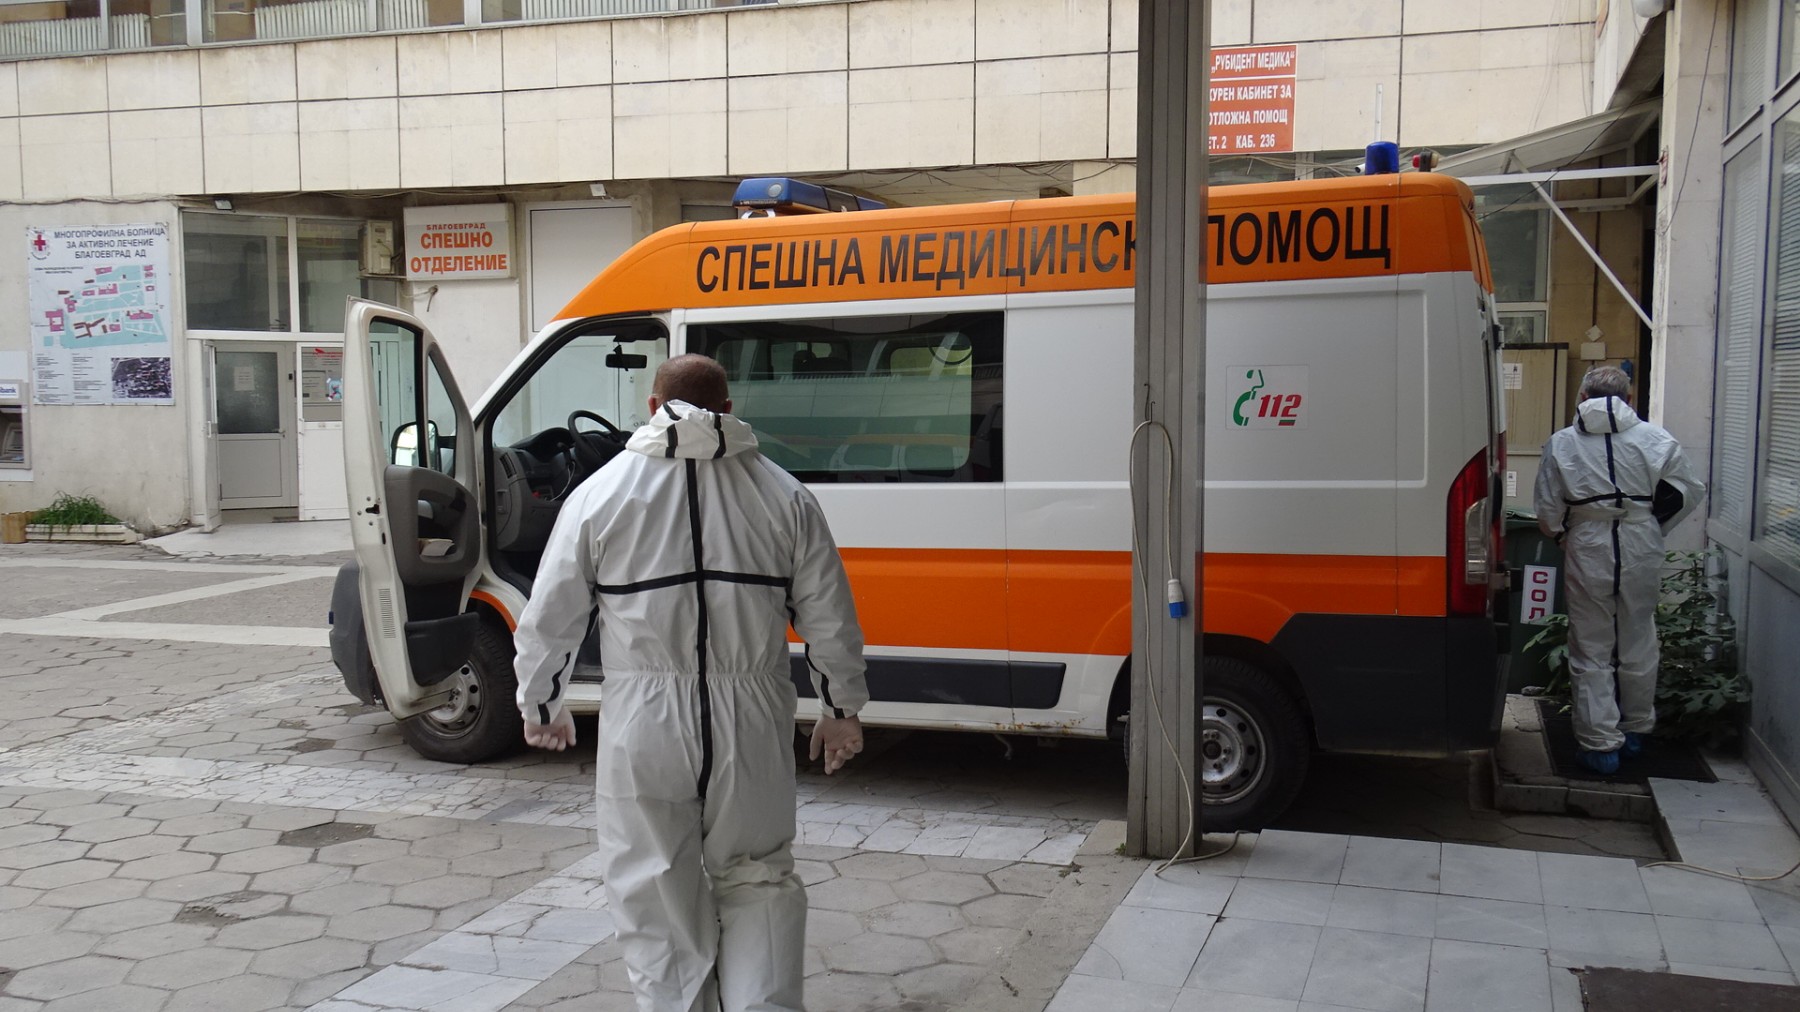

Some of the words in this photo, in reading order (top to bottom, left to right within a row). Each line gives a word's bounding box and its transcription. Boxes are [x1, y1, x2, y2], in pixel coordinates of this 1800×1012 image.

[1237, 85, 1279, 101] КАБИНЕТ
[1280, 84, 1292, 99] ЗА
[1253, 109, 1288, 125] ПОМОЩ
[1221, 135, 1227, 149] 2
[1235, 134, 1256, 149] КАБ.
[1260, 133, 1275, 148] 236
[54, 229, 125, 239] МНОГОПРОФИЛНА
[127, 227, 166, 239] БОЛНИЦА
[426, 222, 487, 231] БЛАГОЕВГРАД
[66, 240, 77, 249] ЗА
[78, 239, 116, 249] АКТИВНО
[117, 238, 154, 248] ЛЕЧЕНИЕ
[420, 231, 493, 250] СПЕШНО
[75, 249, 131, 260] БЛАГОЕВГРАД
[135, 248, 147, 259] АД
[410, 254, 508, 275] ОТДЕЛЕНИЕ
[696, 237, 865, 293] СПЕШНА
[1258, 394, 1302, 418] 112
